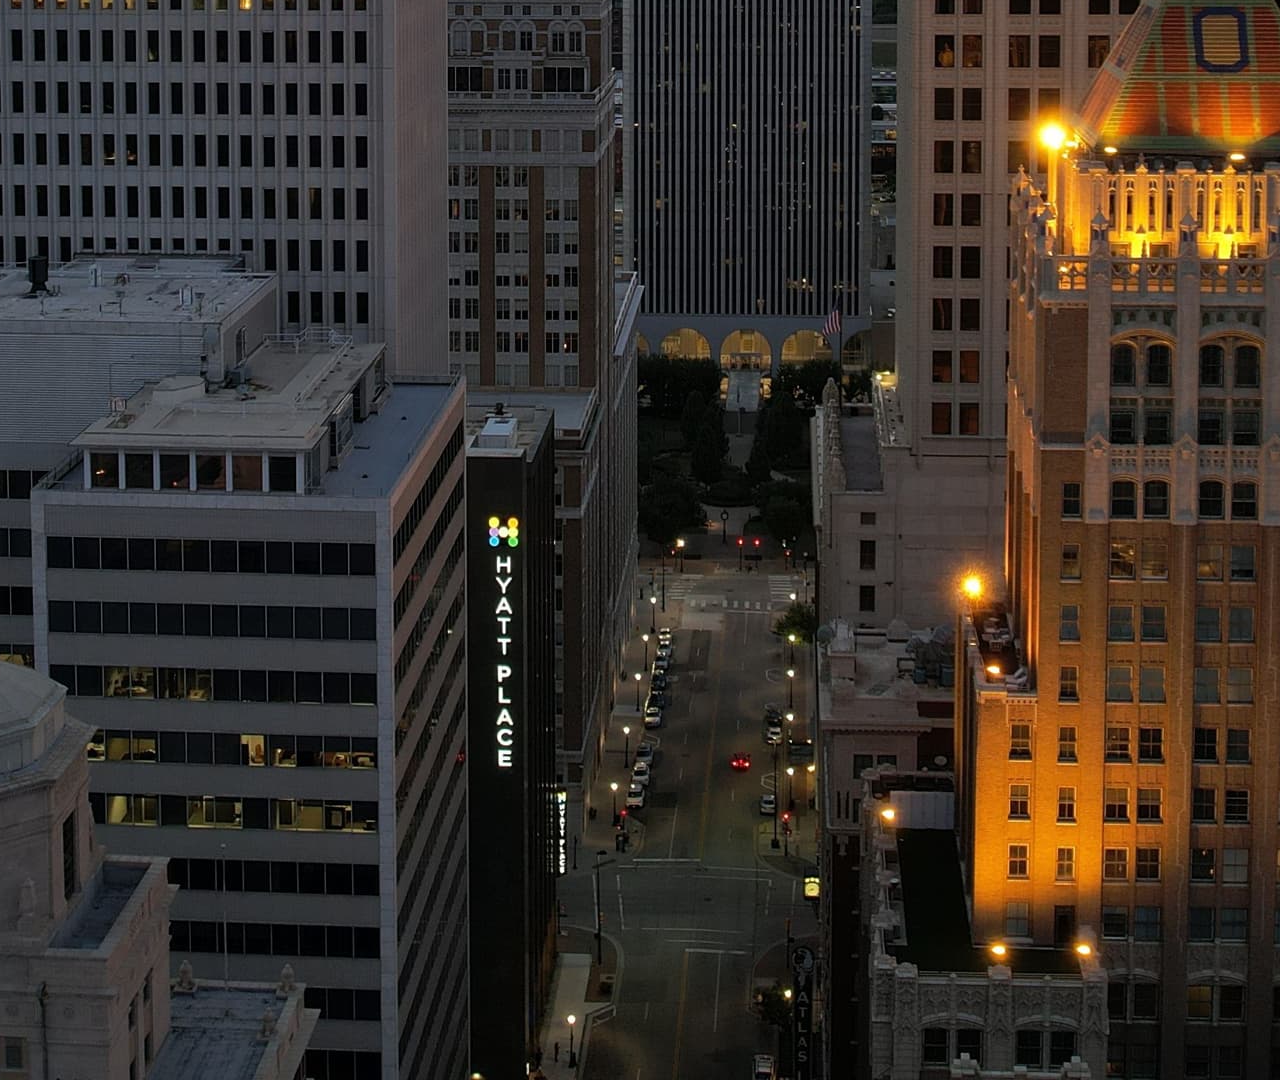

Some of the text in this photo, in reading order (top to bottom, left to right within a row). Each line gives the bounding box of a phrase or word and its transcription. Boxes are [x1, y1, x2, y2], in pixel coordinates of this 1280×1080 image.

[495, 556, 513, 767] HYATT PLACE
[797, 991, 810, 1062] ATLAS
